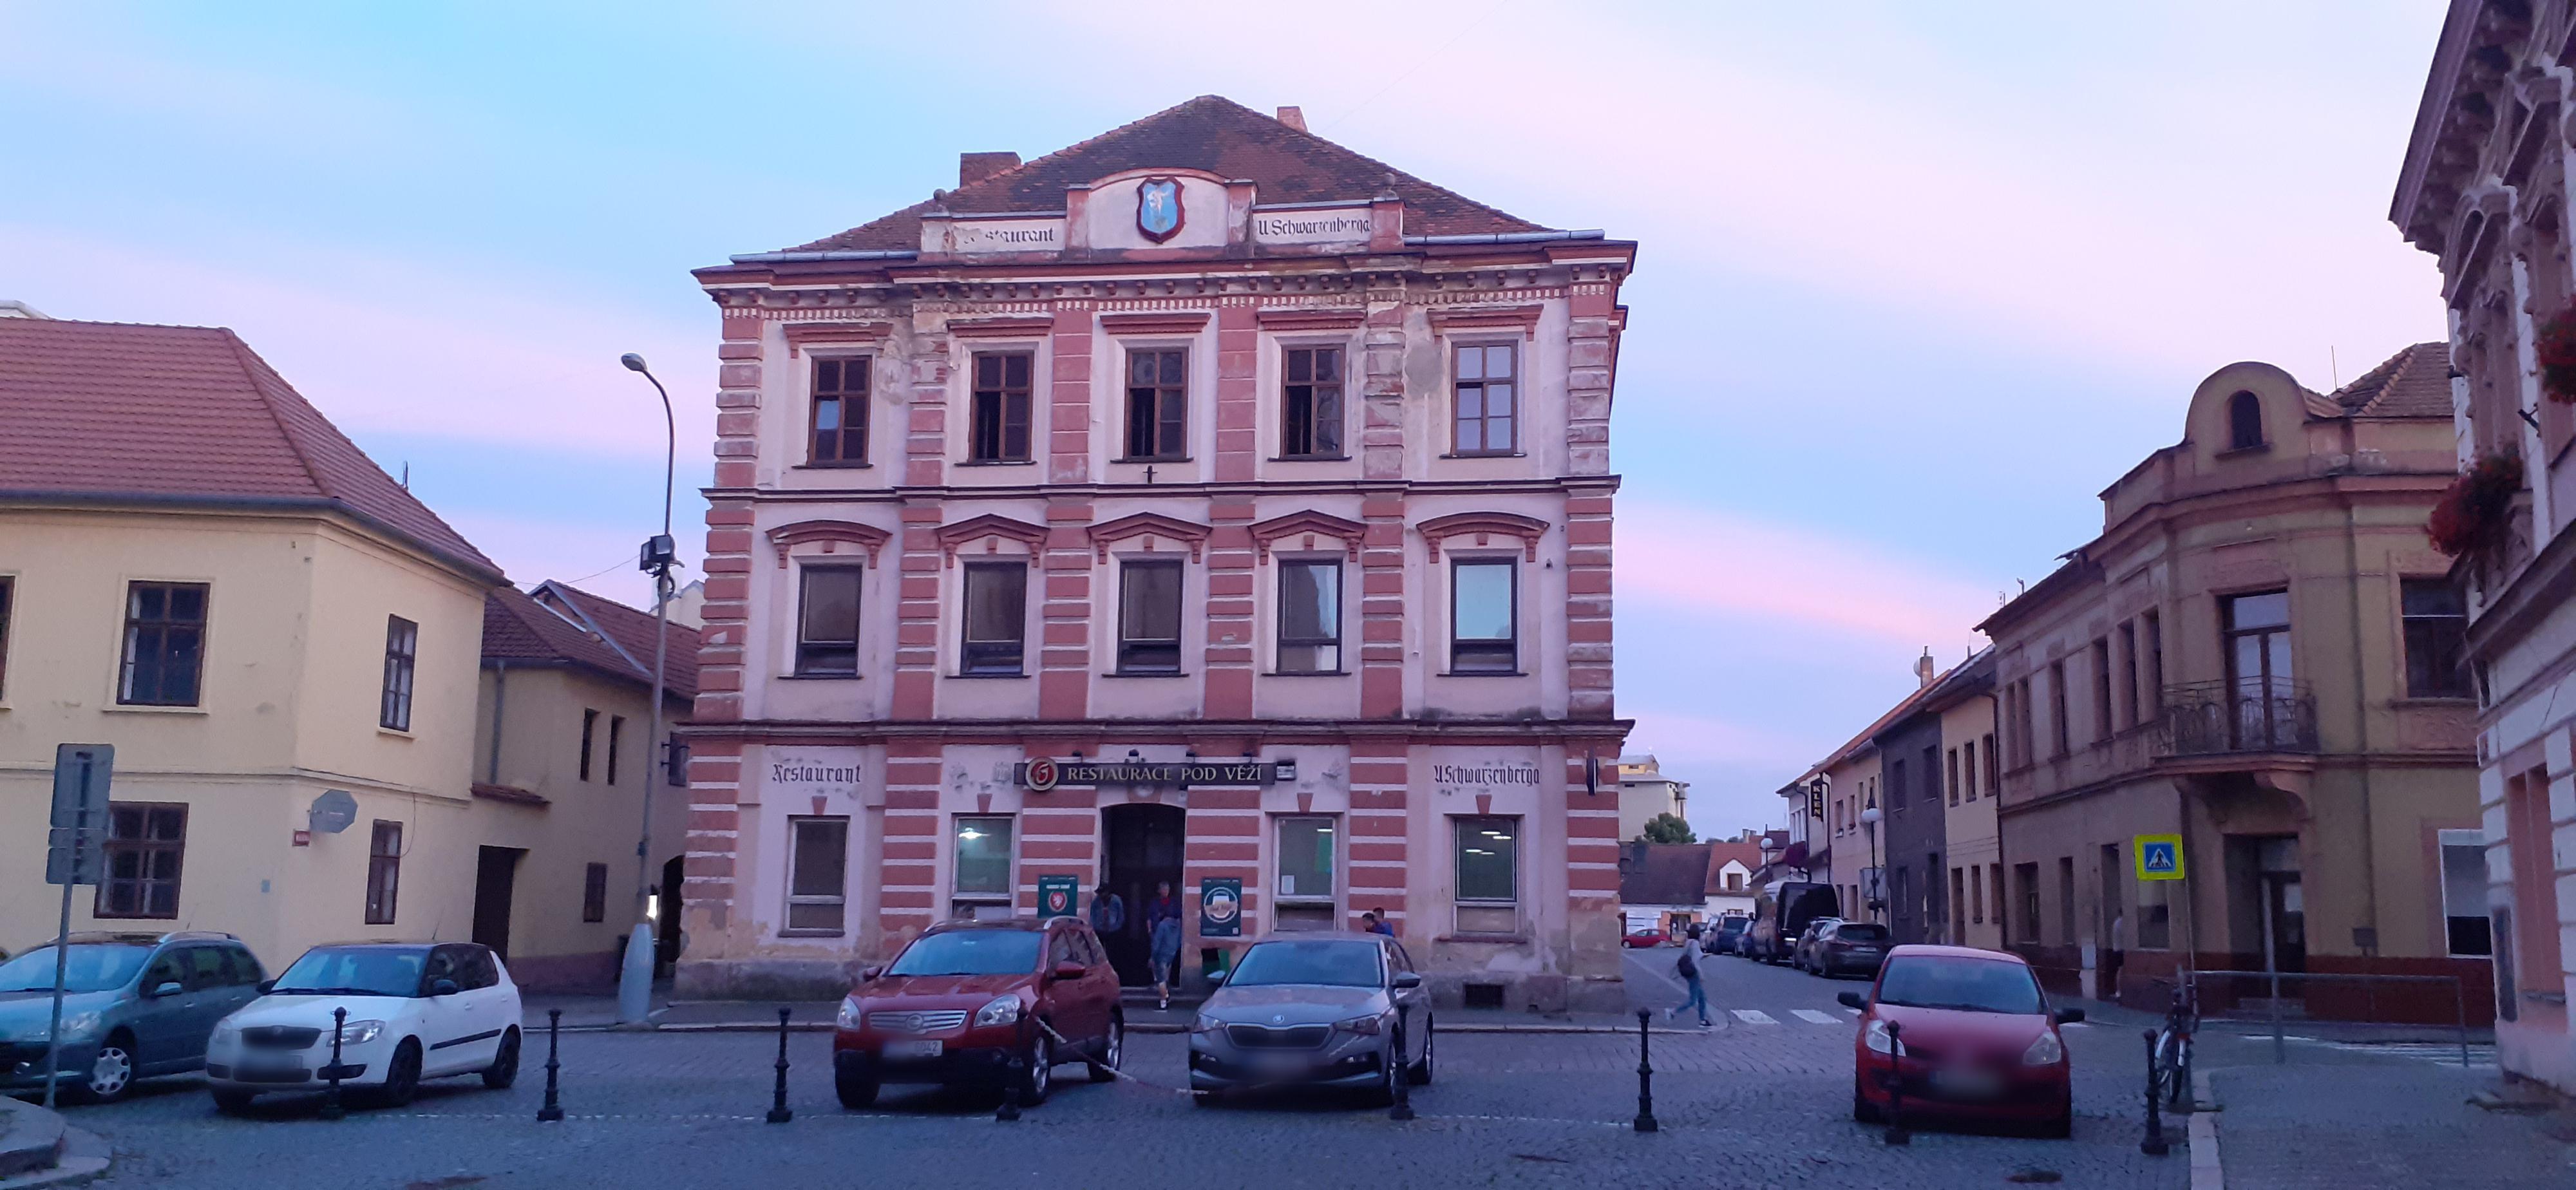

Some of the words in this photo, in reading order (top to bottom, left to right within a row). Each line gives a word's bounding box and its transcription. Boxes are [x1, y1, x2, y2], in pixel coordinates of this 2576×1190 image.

[772, 763, 861, 784] Restaurant
[1067, 766, 1171, 780] RESTAURACE
[1181, 766, 1217, 780] POD
[1225, 764, 1261, 780] VĚŽÍ
